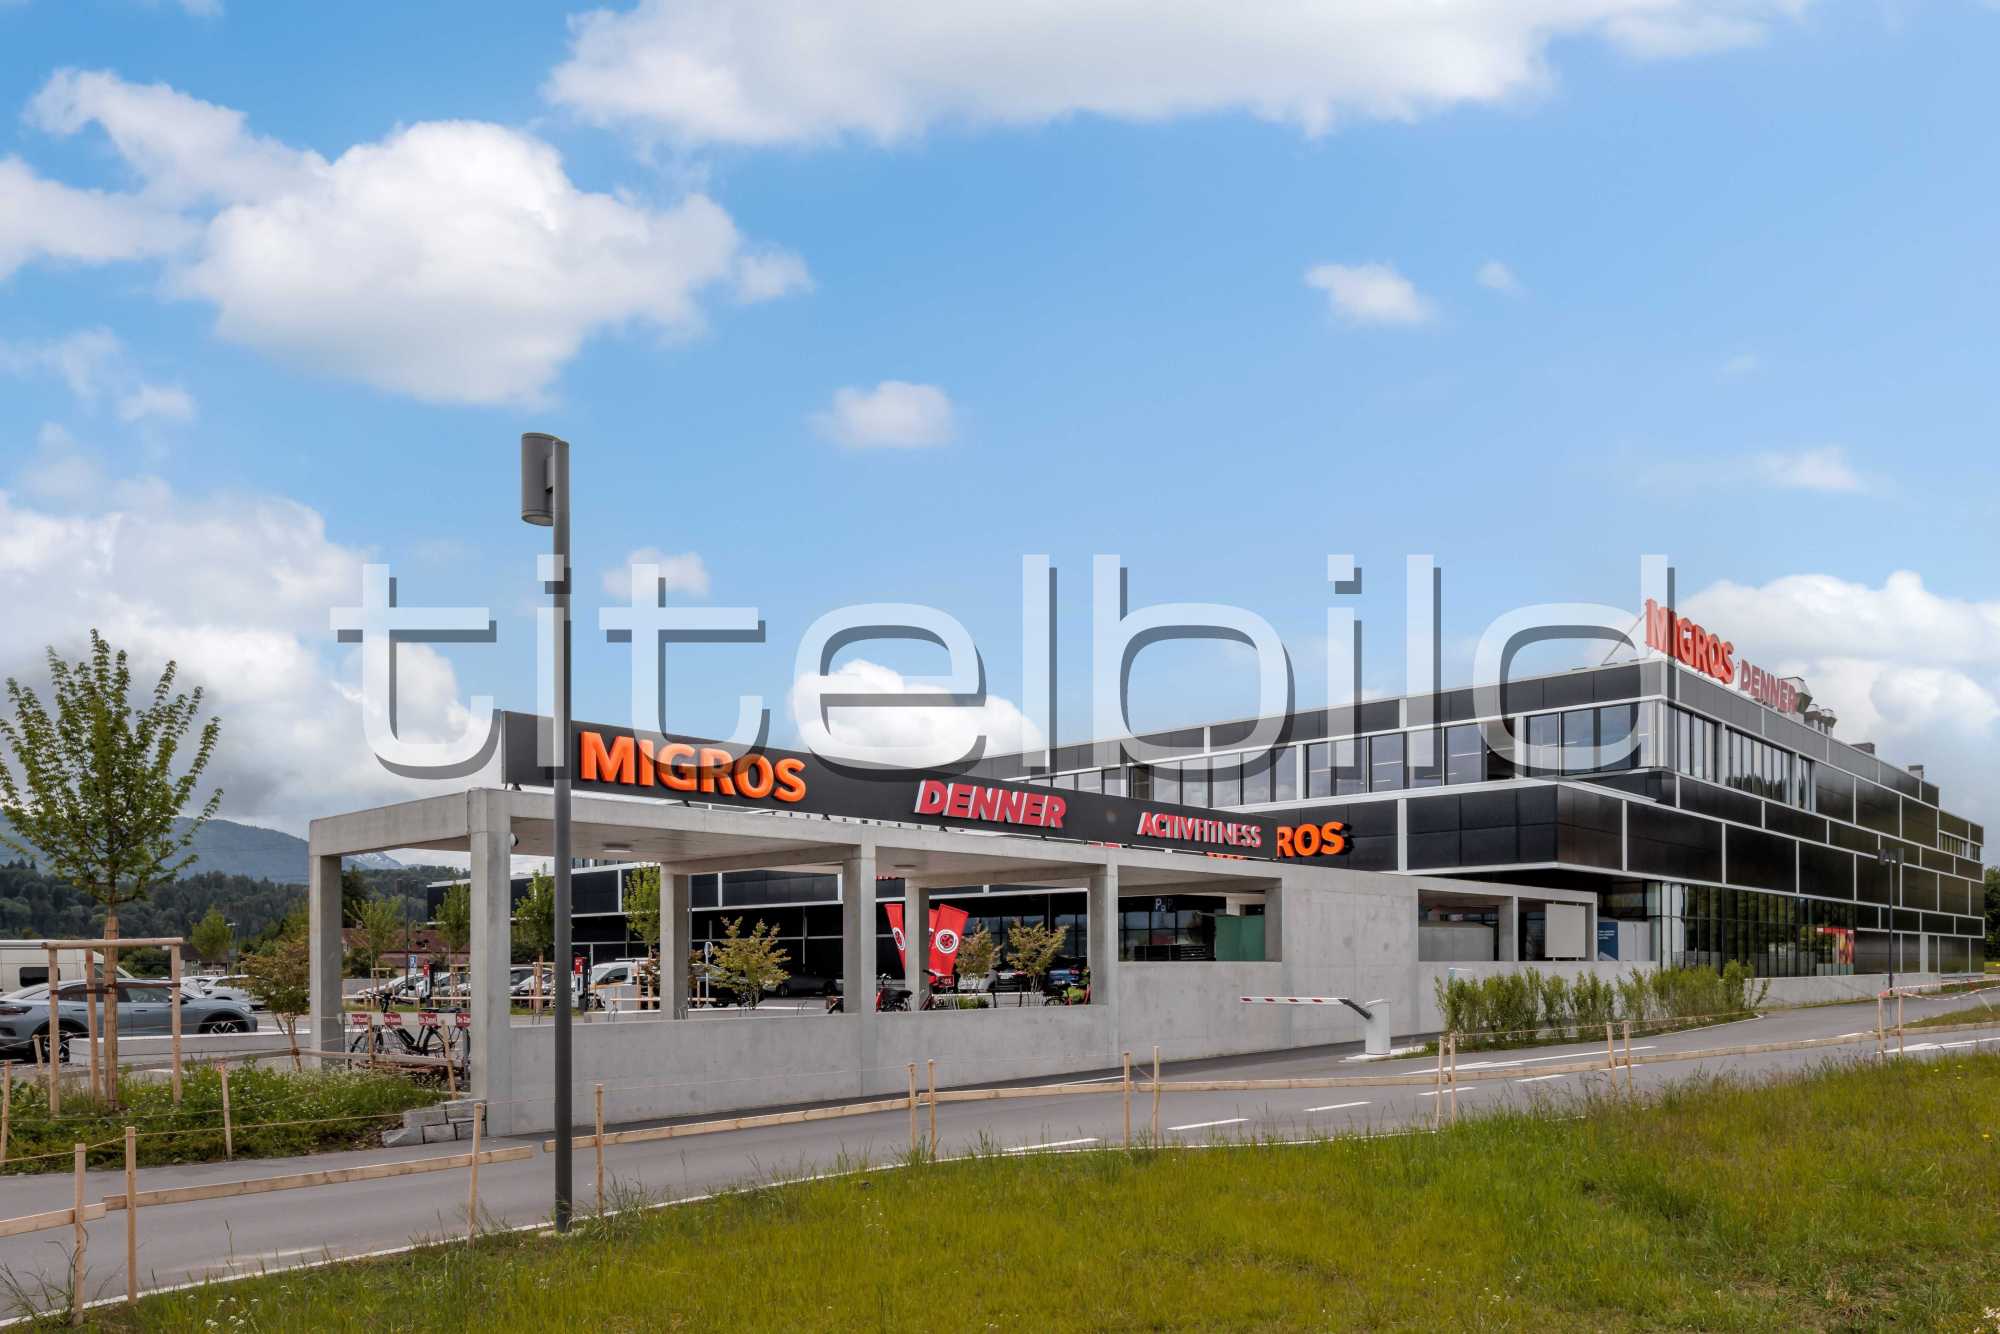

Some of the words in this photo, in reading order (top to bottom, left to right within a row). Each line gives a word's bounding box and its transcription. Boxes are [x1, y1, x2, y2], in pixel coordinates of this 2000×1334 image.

[1645, 598, 1735, 684] MIGROS
[1740, 659, 1800, 714] DENNER
[580, 731, 806, 802] MIGROS
[914, 779, 1067, 828] DENNER
